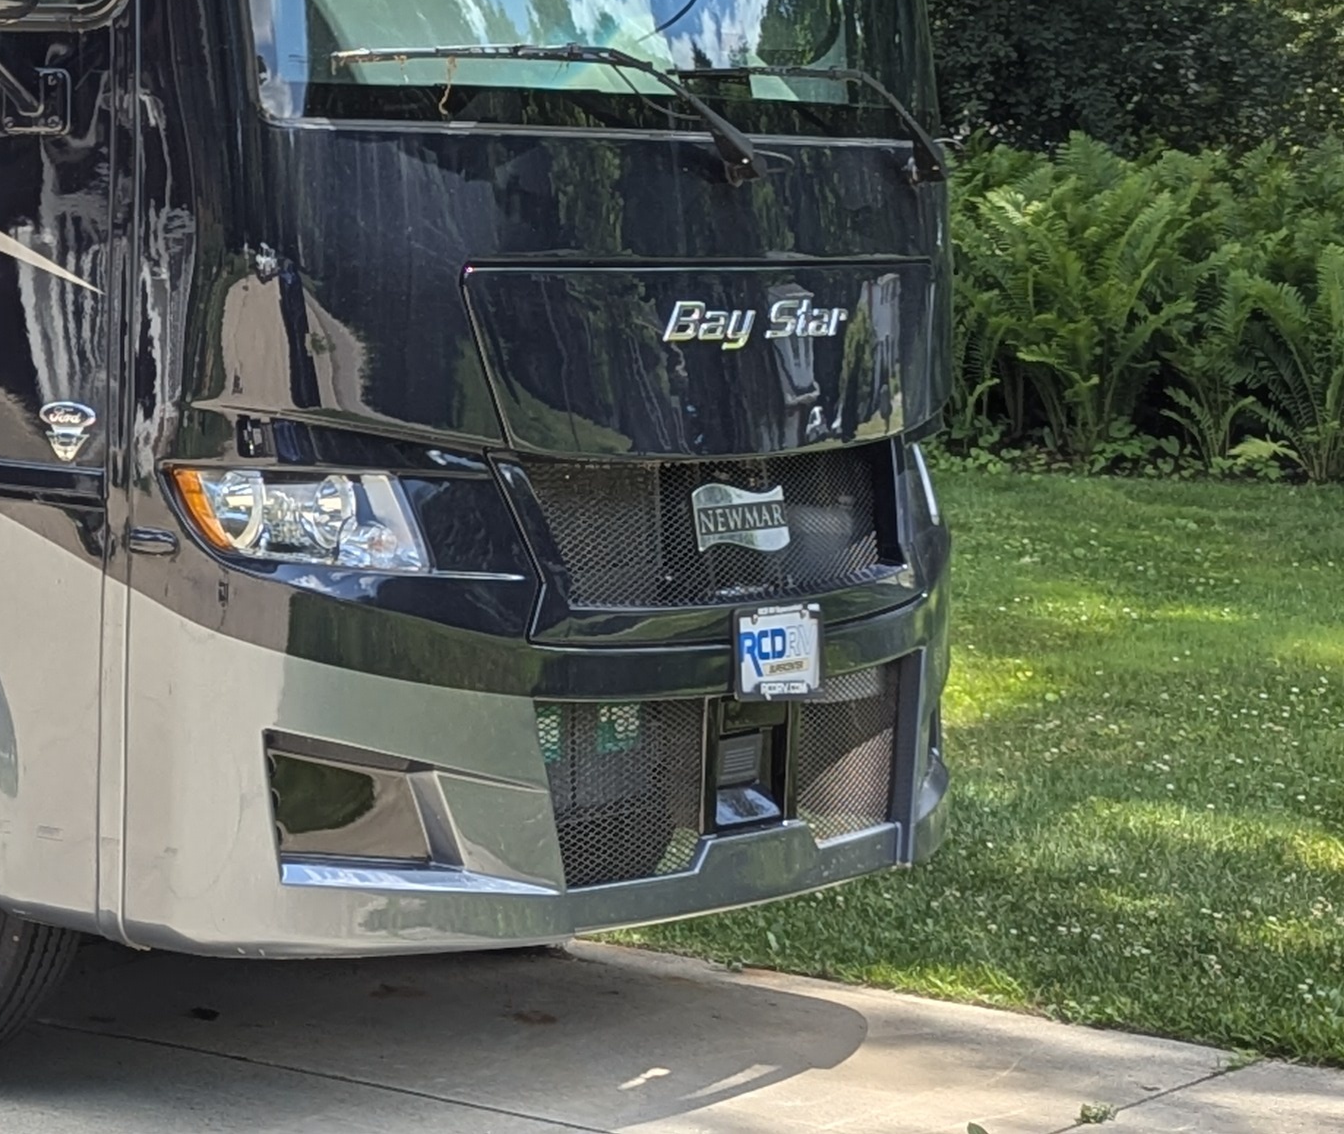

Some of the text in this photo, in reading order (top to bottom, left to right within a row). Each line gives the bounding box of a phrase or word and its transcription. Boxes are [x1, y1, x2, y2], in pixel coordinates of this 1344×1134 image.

[663, 299, 849, 350] Bay Star
[49, 406, 82, 424] Ford
[699, 504, 787, 533] NEWMAR
